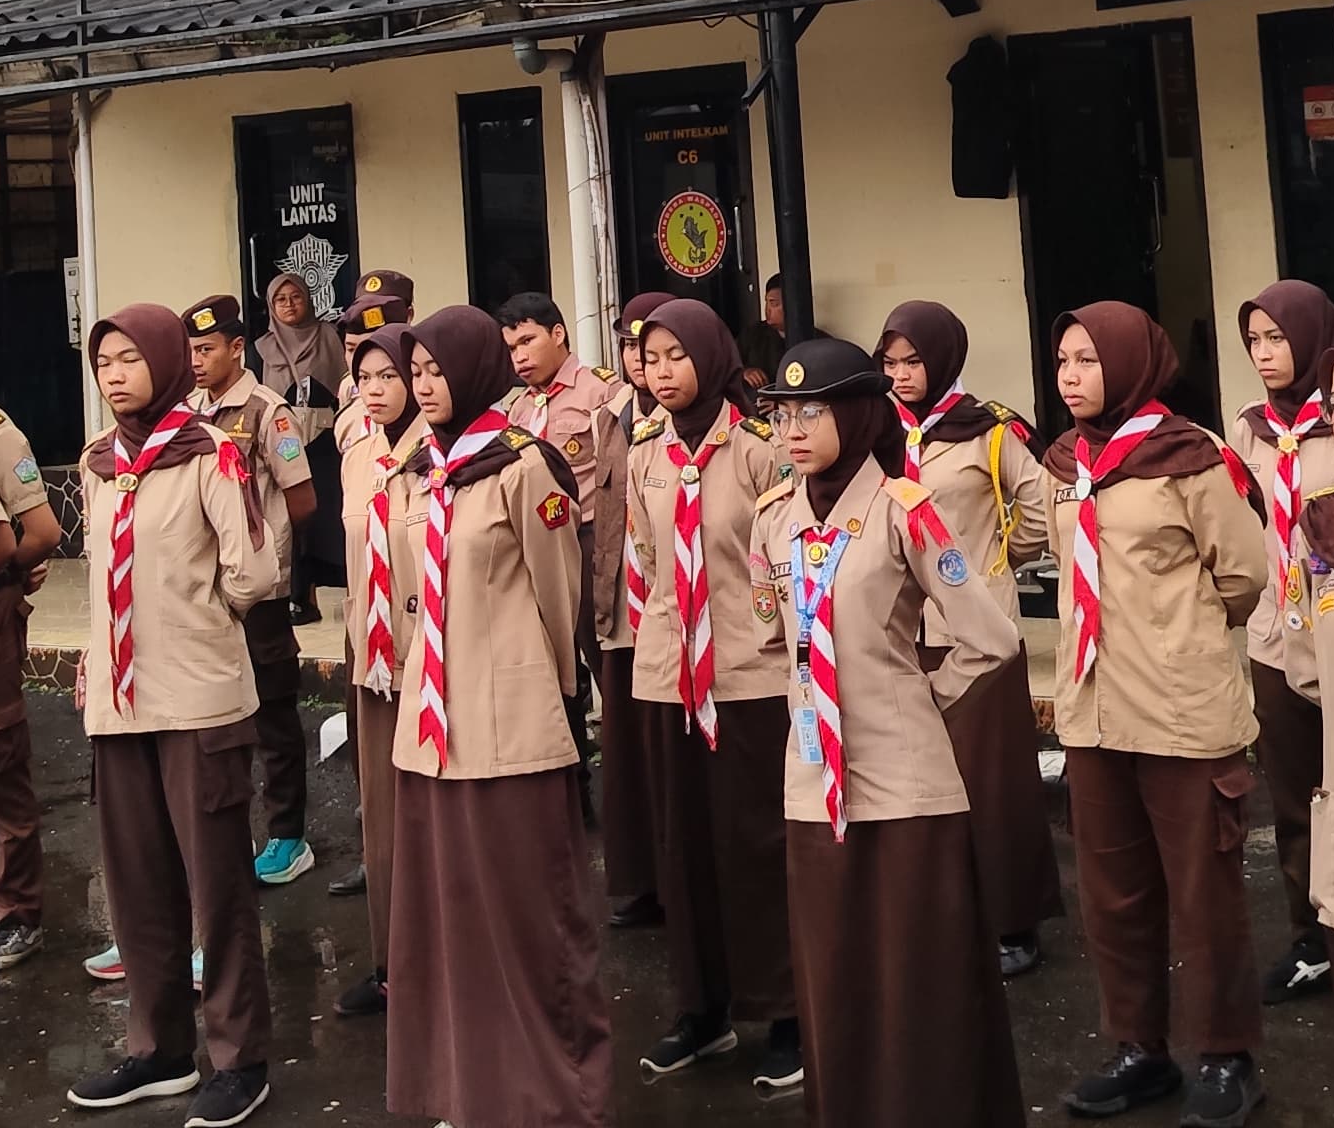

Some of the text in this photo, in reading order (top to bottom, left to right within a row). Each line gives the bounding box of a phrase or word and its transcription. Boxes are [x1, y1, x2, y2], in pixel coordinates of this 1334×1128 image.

[645, 124, 729, 142] UNIT INTELKAM
[677, 149, 699, 165] C6
[289, 182, 326, 205] UNIT
[280, 202, 337, 227] LANTAS
